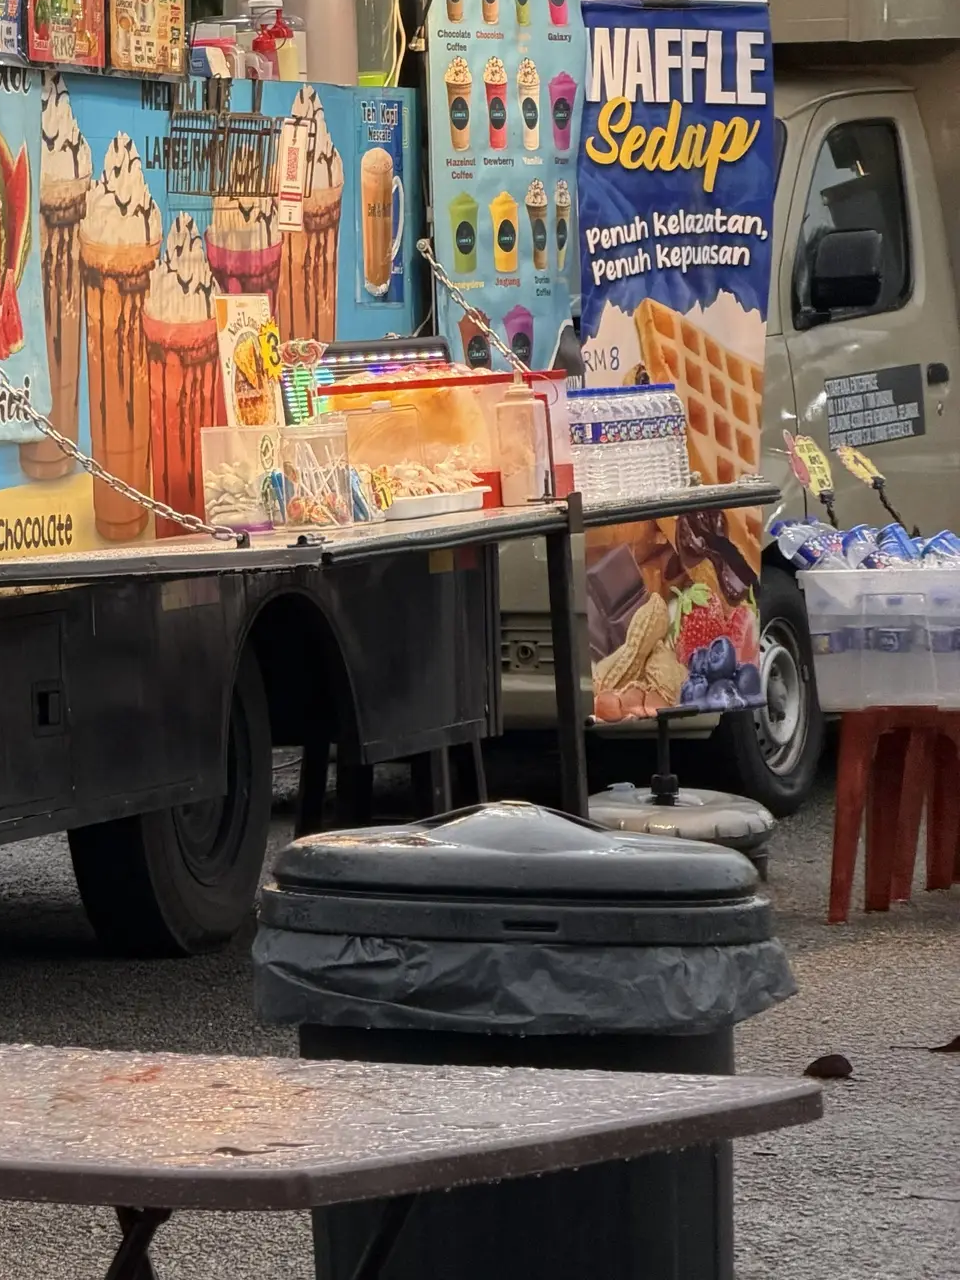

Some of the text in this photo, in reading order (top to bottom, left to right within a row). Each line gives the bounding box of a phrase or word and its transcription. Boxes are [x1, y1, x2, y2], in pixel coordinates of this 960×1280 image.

[437, 29, 471, 39] Chocolate
[476, 31, 504, 40] Chocolate
[548, 33, 571, 42] Galaxy
[446, 42, 467, 52] Coffee
[585, 28, 767, 105] WAFFLE
[585, 96, 760, 193] Sedap
[446, 157, 476, 167] Hazelnut
[483, 157, 515, 167] Dewberry
[451, 171, 473, 179] Coffee
[266, 332, 281, 366] 3
